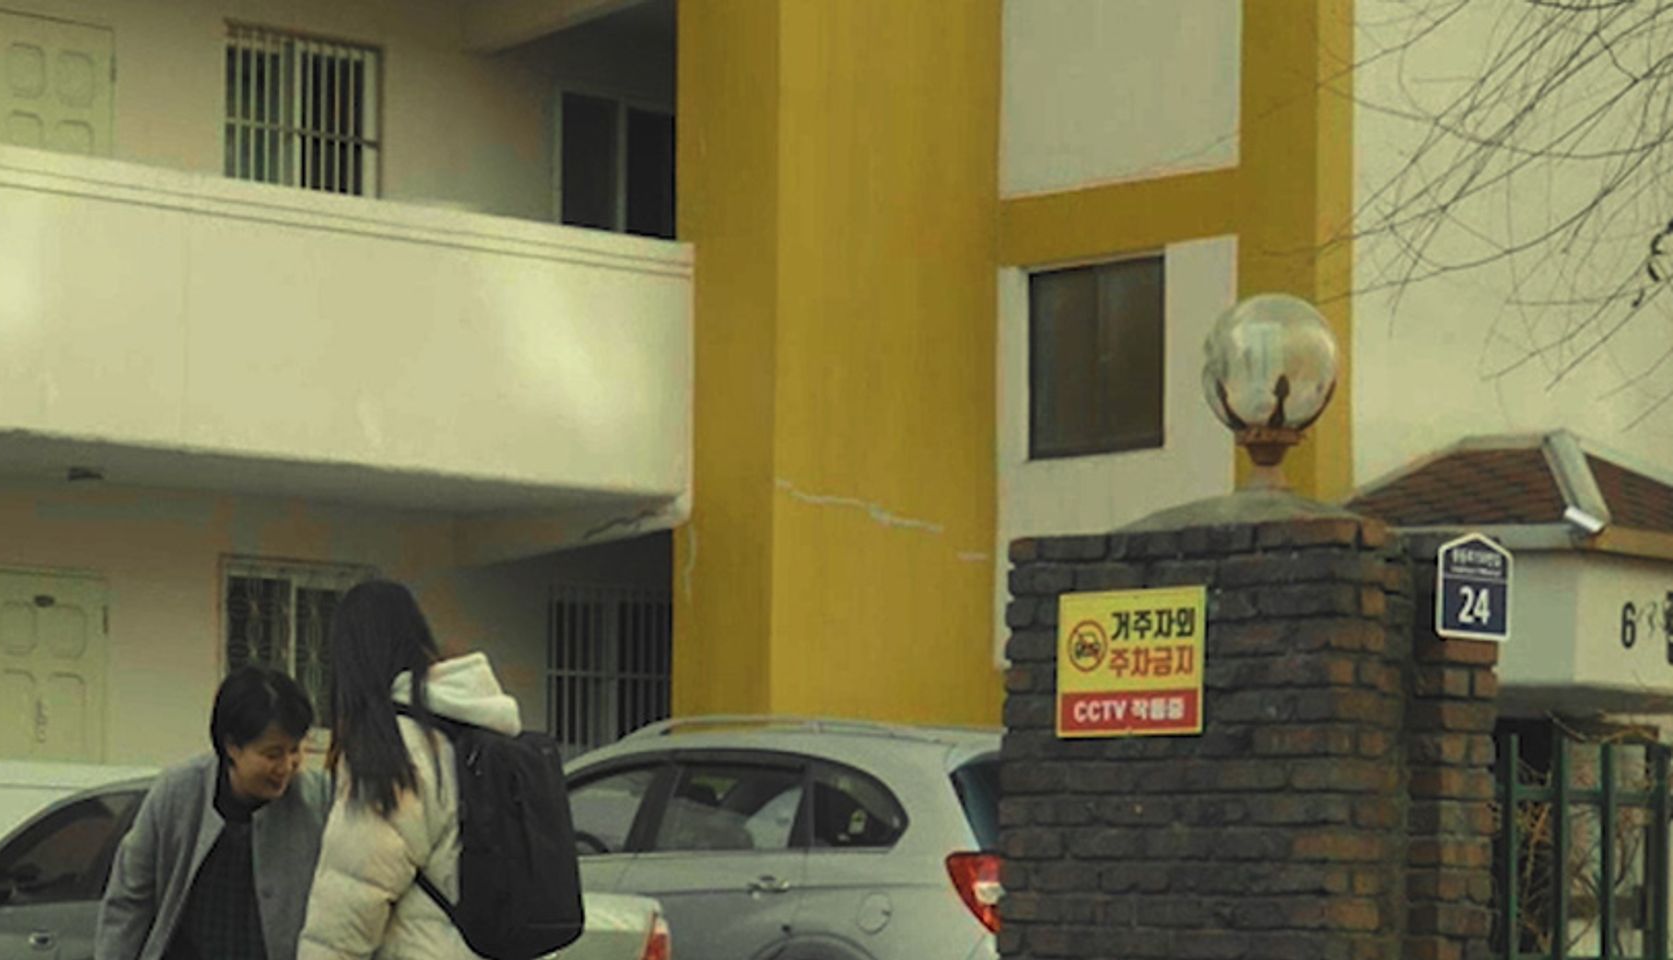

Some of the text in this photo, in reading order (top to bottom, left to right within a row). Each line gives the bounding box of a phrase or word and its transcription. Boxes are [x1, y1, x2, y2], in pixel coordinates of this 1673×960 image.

[1458, 585, 1491, 625] 24
[1111, 607, 1196, 640] 거주자외
[1621, 601, 1636, 650] 6
[1109, 644, 1194, 678] 주차금지
[1073, 700, 1127, 723] CCTV
